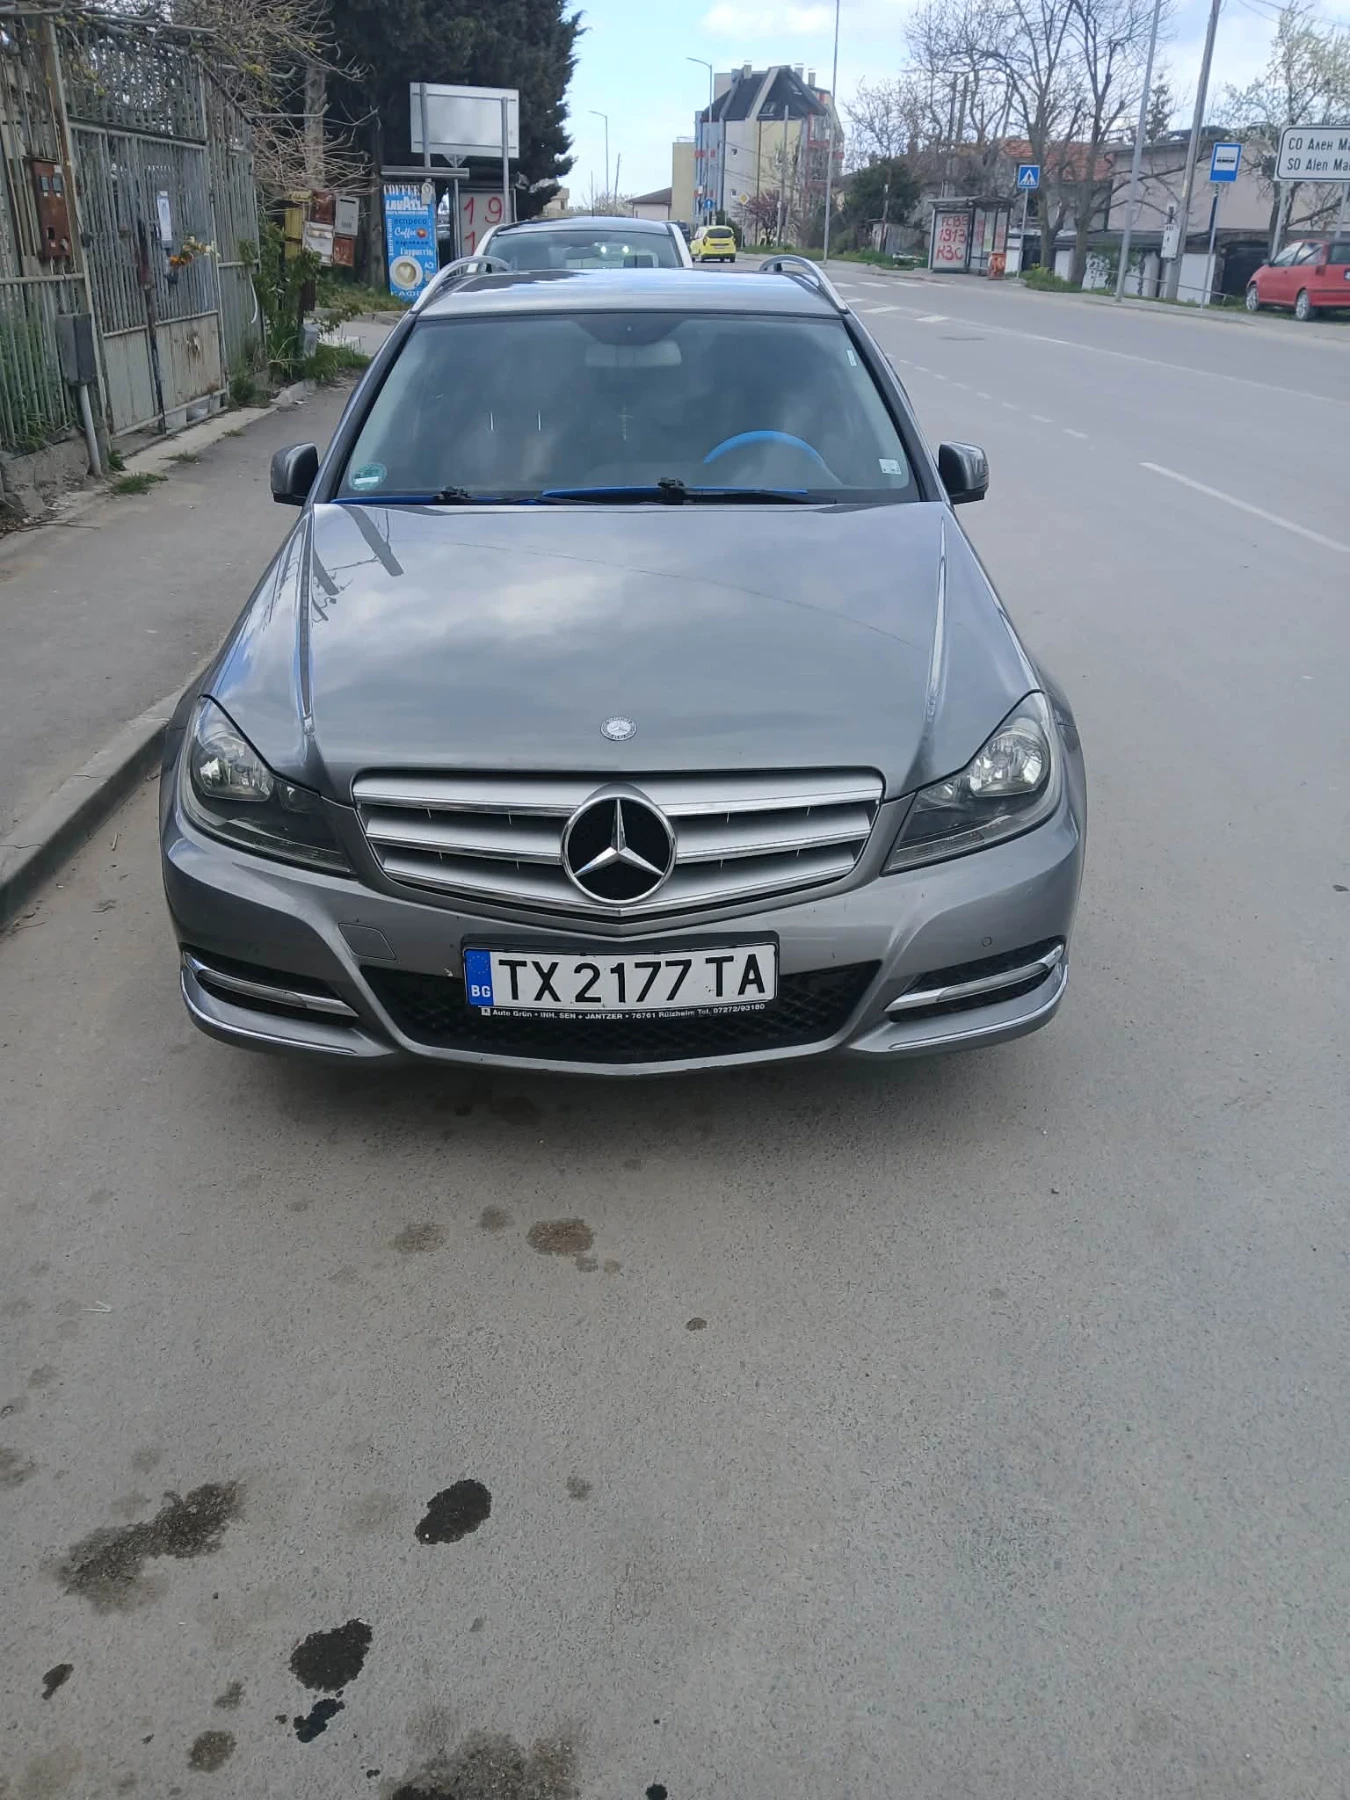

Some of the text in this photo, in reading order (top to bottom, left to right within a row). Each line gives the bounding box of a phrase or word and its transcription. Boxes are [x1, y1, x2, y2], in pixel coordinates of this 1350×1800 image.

[1308, 137, 1333, 151] Ален
[1287, 157, 1301, 171] SO
[1306, 158, 1328, 171] Alen
[383, 184, 420, 196] COFFEE
[498, 953, 766, 1004] TX 2177 TA
[471, 984, 491, 997] BG
[492, 1009, 511, 1017] Auto
[512, 1010, 533, 1018] Grün
[585, 1012, 623, 1020] JANTZER
